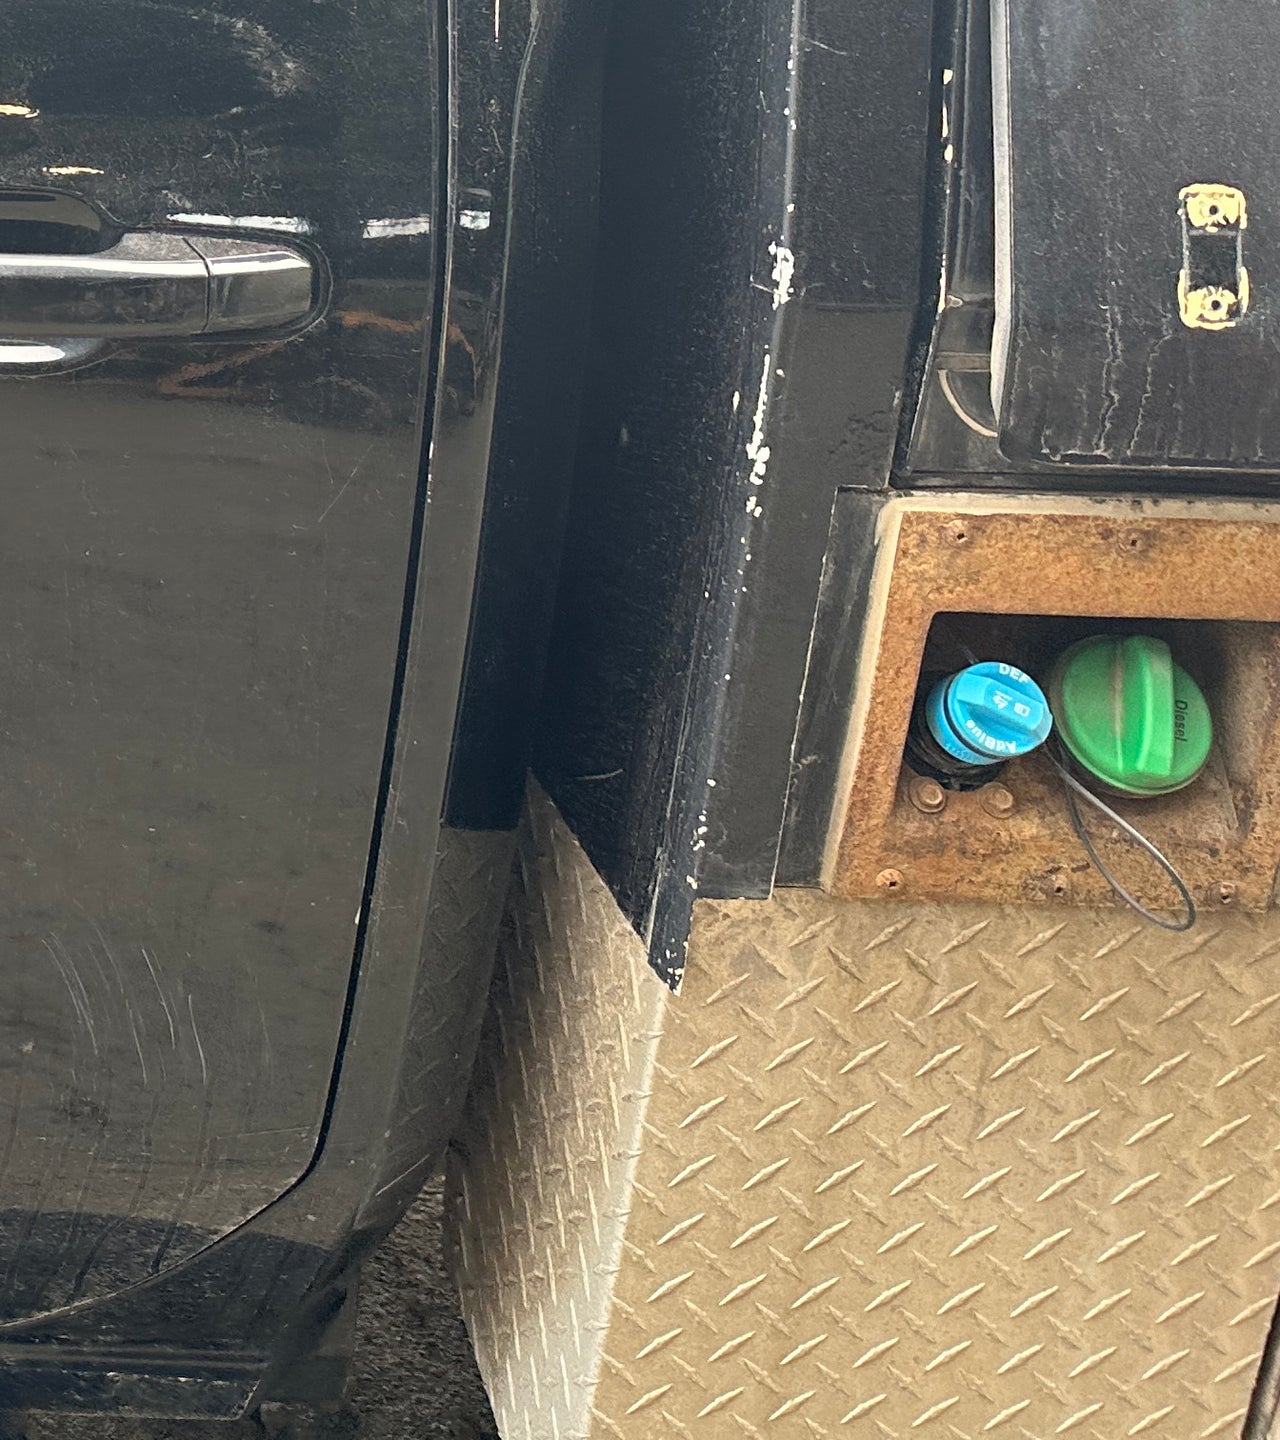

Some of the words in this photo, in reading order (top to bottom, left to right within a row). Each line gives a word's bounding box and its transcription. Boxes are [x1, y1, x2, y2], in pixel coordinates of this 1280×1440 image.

[998, 662, 1031, 684] DEF
[965, 719, 1018, 754] AdBlue
[1174, 700, 1188, 742] Diesel
